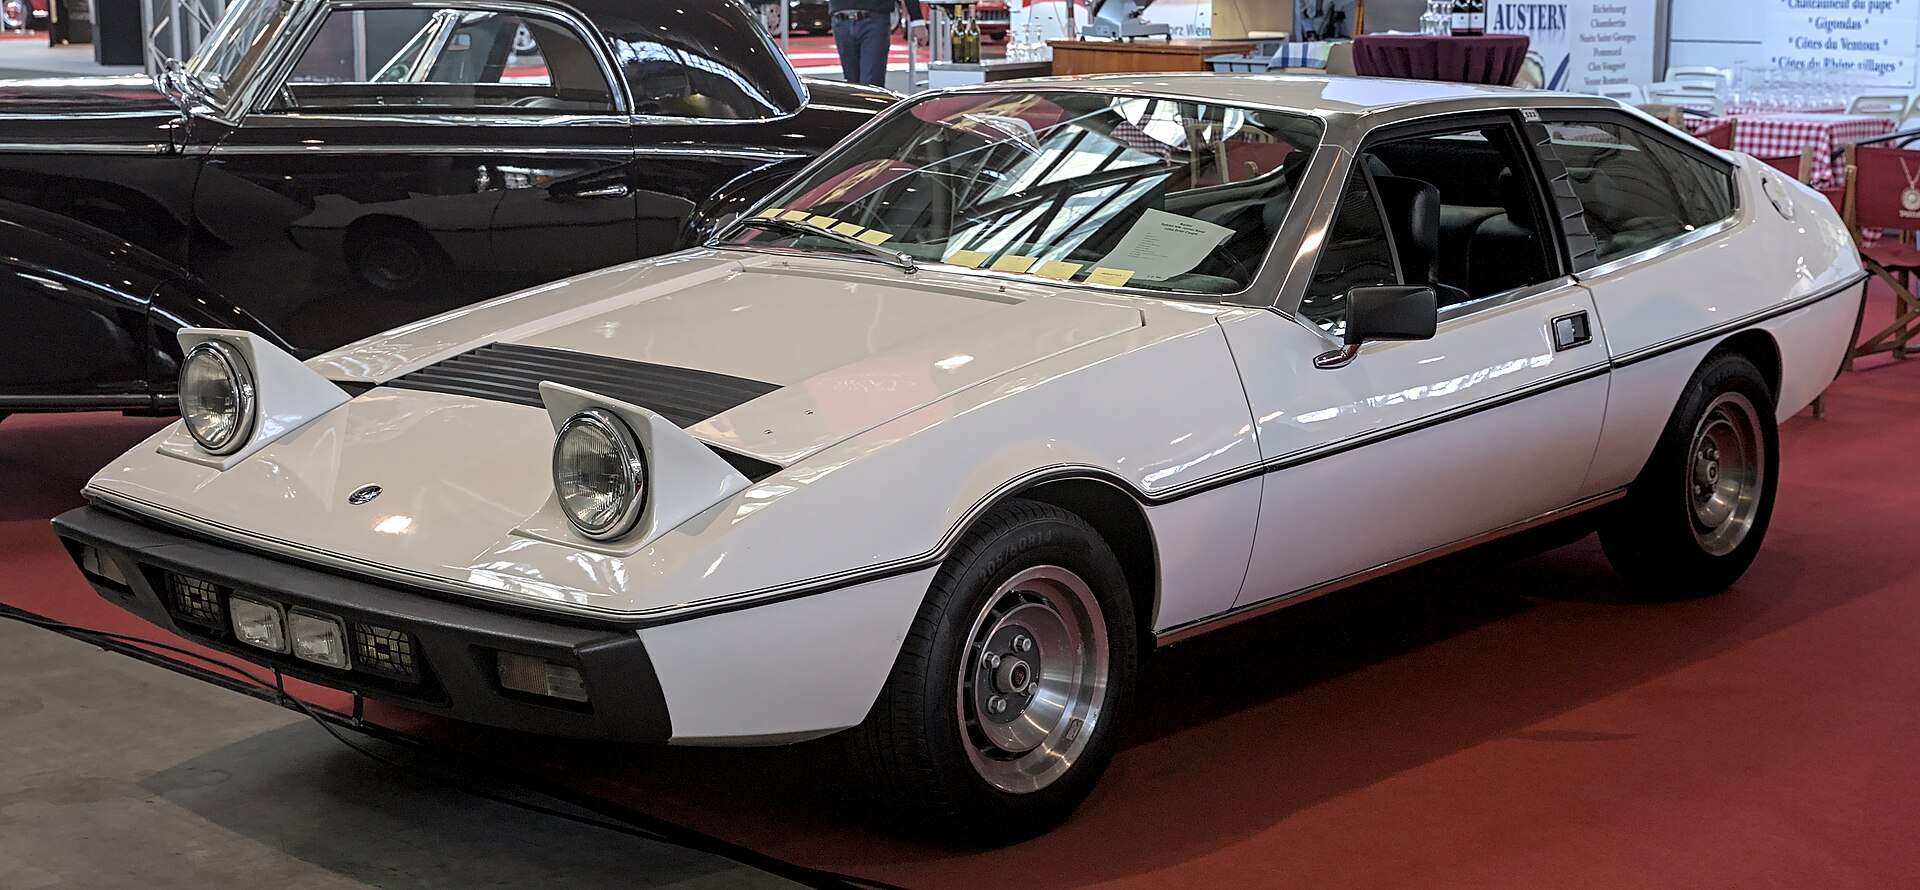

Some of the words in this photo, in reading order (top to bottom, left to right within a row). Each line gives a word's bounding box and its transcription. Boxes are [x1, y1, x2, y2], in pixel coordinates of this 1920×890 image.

[1867, 0, 1893, 14] pape
[1493, 4, 1568, 31] AUSTERN
[1814, 16, 1862, 33] Gigondas
[1824, 37, 1839, 49] du
[1840, 37, 1880, 51] Ventoux
